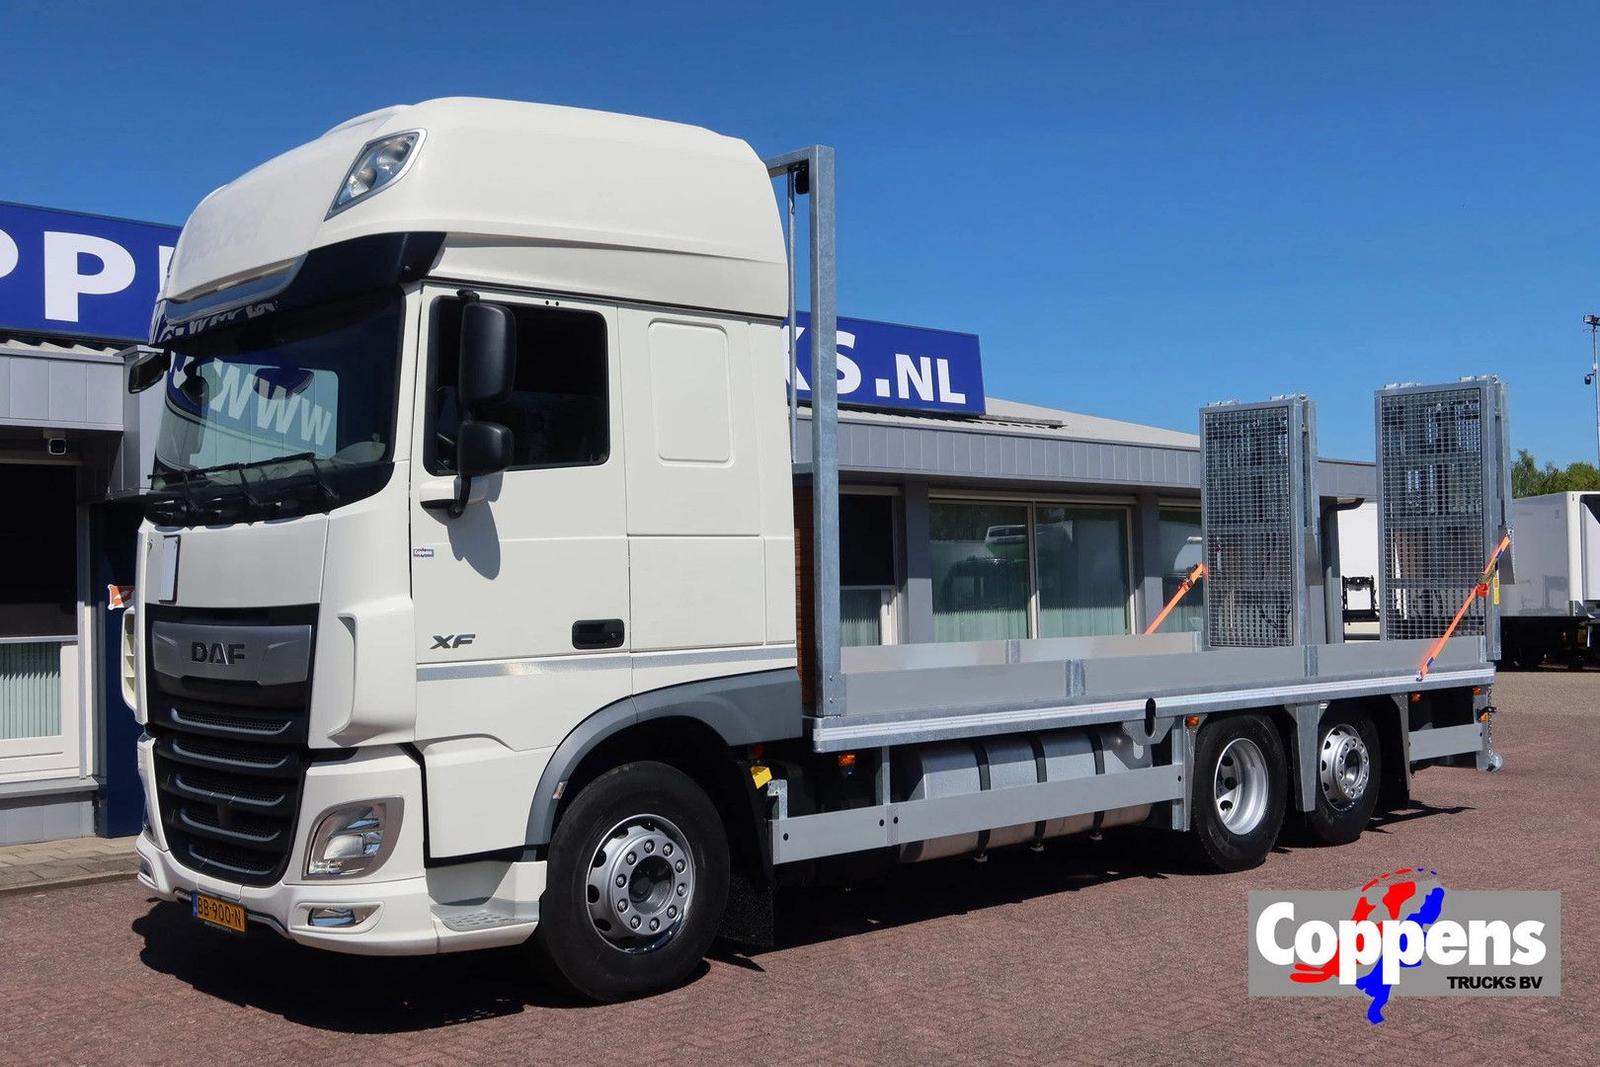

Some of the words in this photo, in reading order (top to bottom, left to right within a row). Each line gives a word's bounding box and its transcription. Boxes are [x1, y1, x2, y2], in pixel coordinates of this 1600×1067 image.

[191, 641, 245, 665] DAF
[429, 633, 475, 650] XF
[198, 897, 242, 928] BB-900-N
